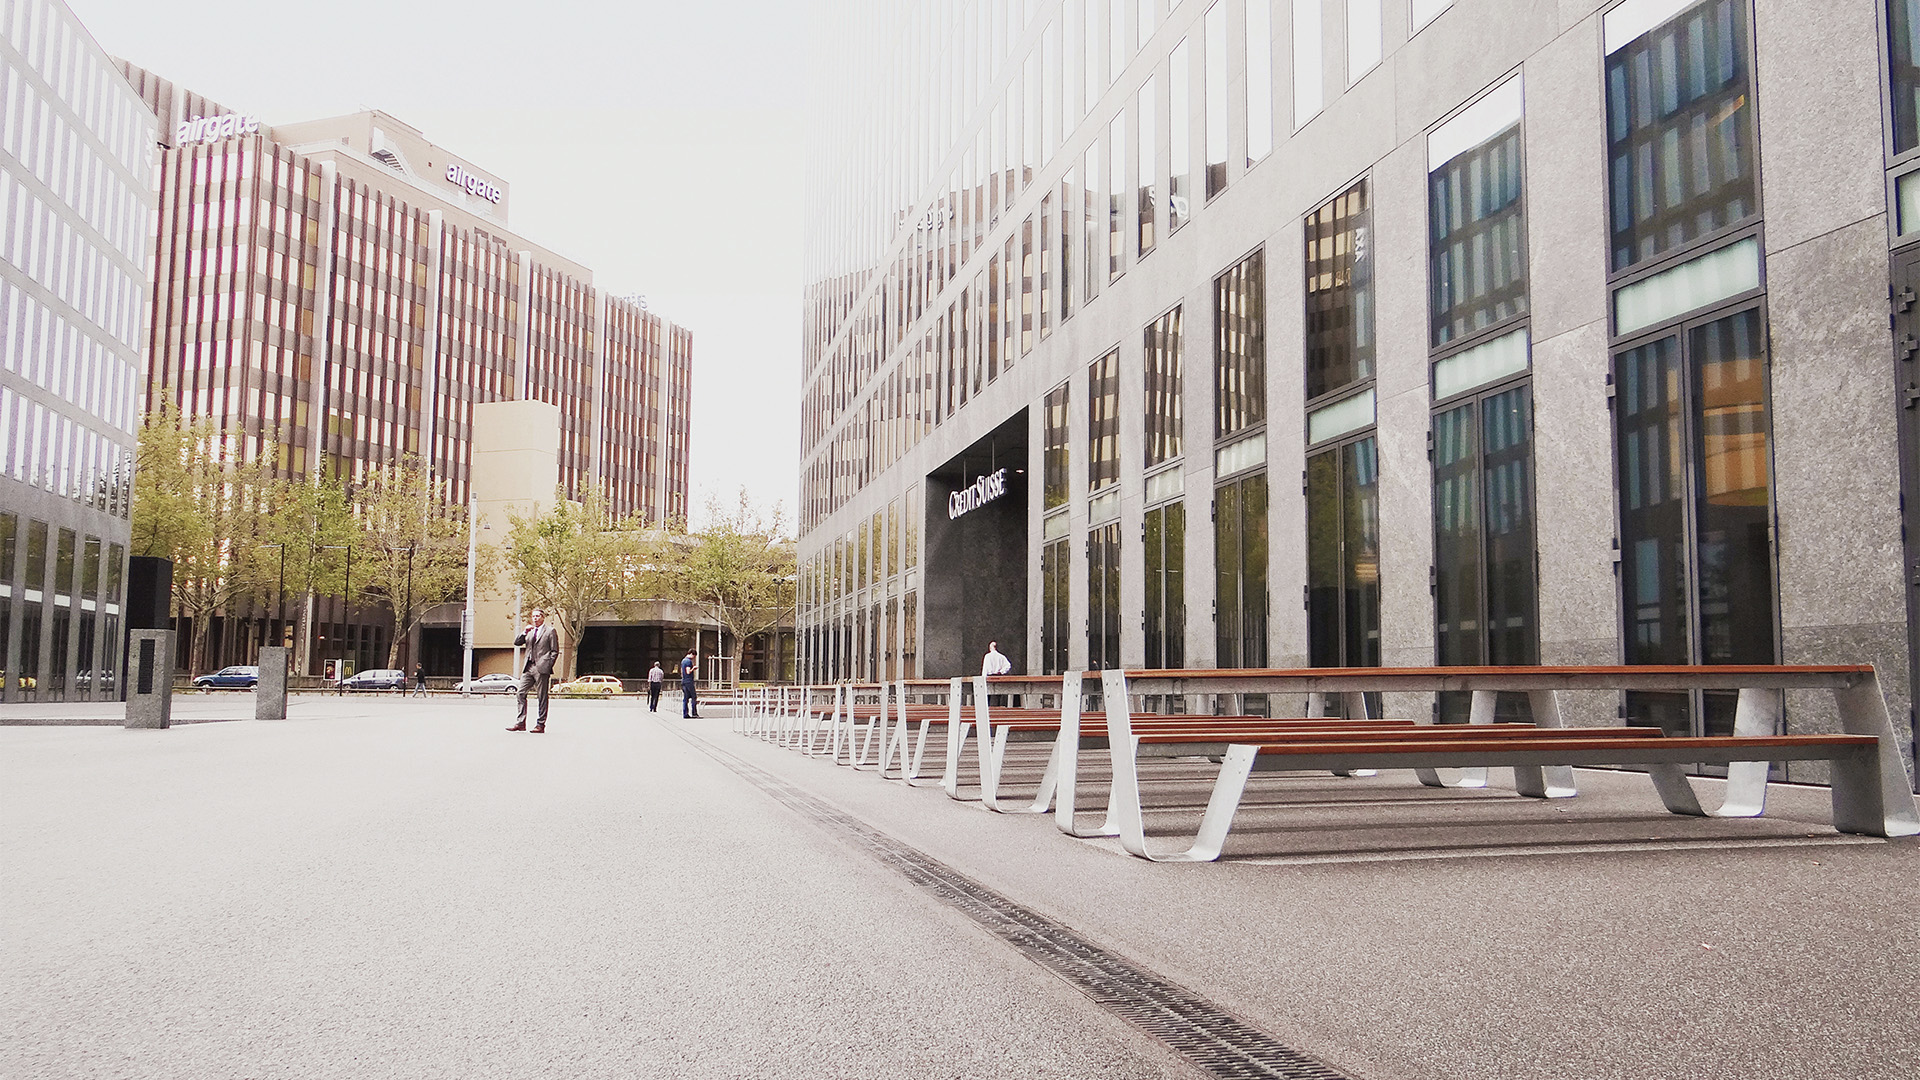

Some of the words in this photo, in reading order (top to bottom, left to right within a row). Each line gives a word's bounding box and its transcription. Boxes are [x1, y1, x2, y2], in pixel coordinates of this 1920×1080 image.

[176, 111, 259, 146] airgate
[446, 164, 501, 204] airgate
[948, 483, 977, 520] CREDIT
[976, 467, 1006, 506] SUISSE
